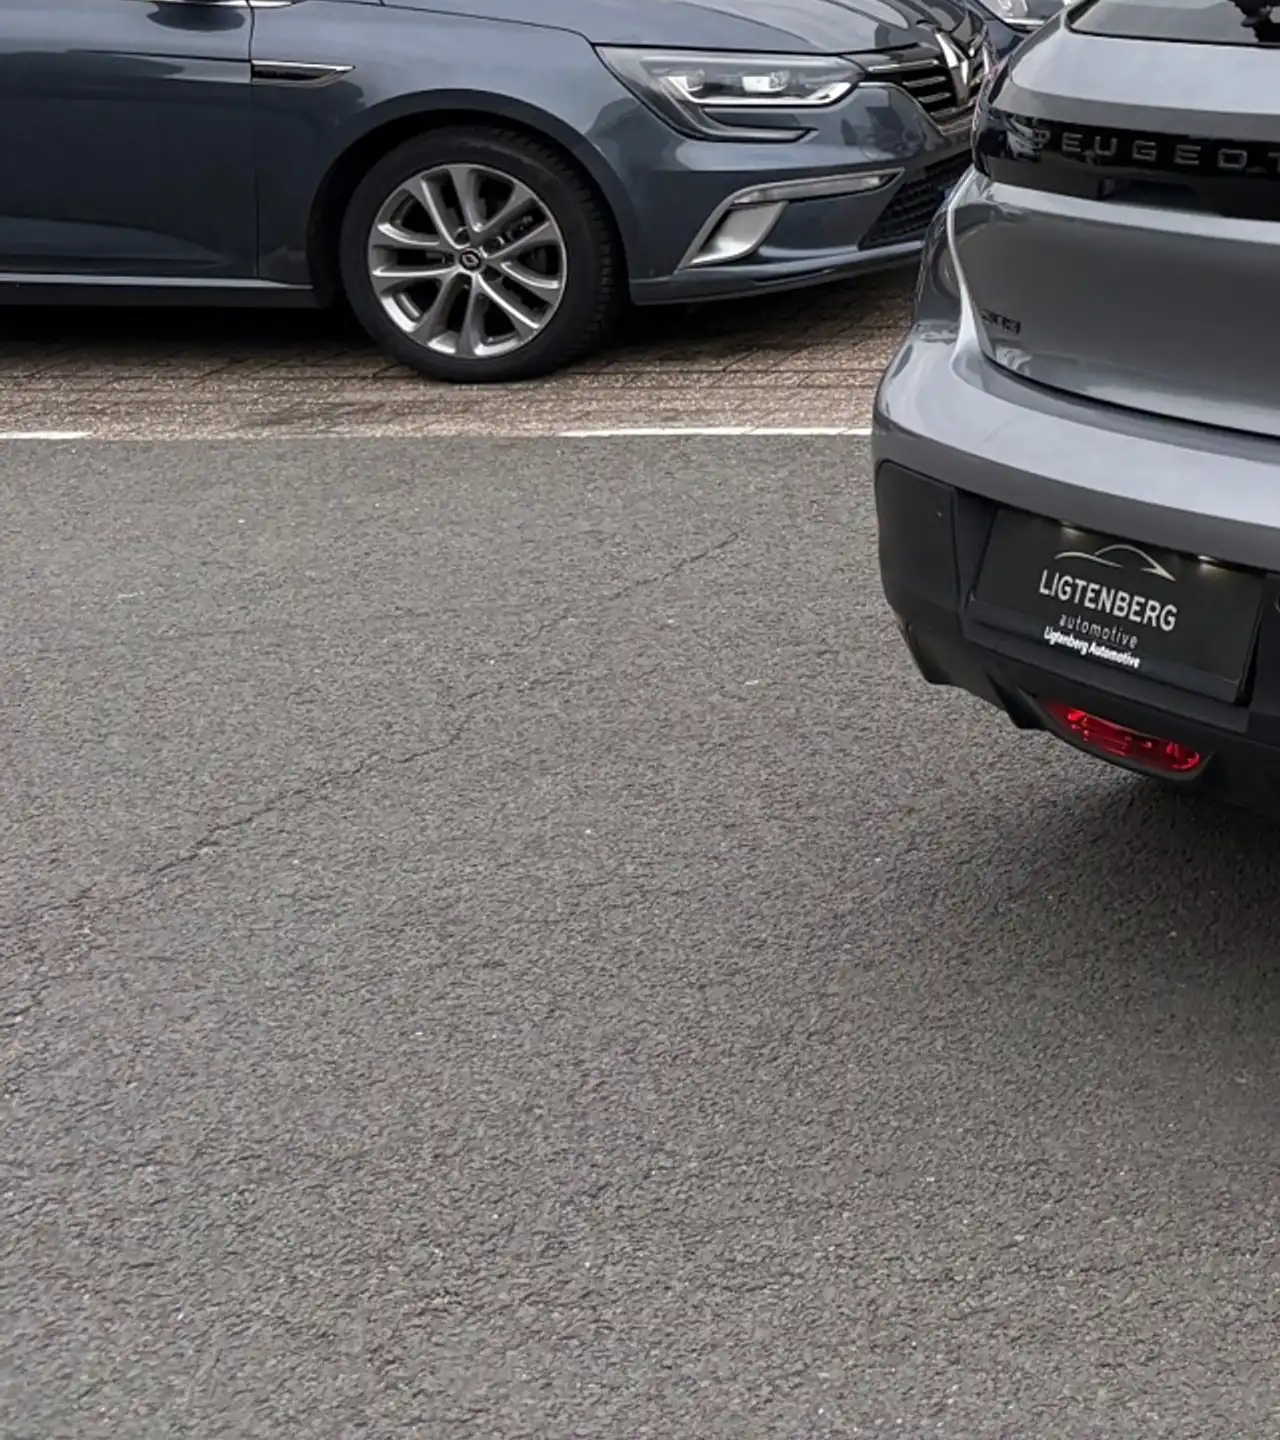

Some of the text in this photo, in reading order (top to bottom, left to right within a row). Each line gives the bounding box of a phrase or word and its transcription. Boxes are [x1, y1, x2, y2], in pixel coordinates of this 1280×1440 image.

[1038, 568, 1179, 632] LIGTENBERG
[1043, 625, 1142, 669] Ligtenberg Automotive
[1059, 613, 1139, 649] automotive
